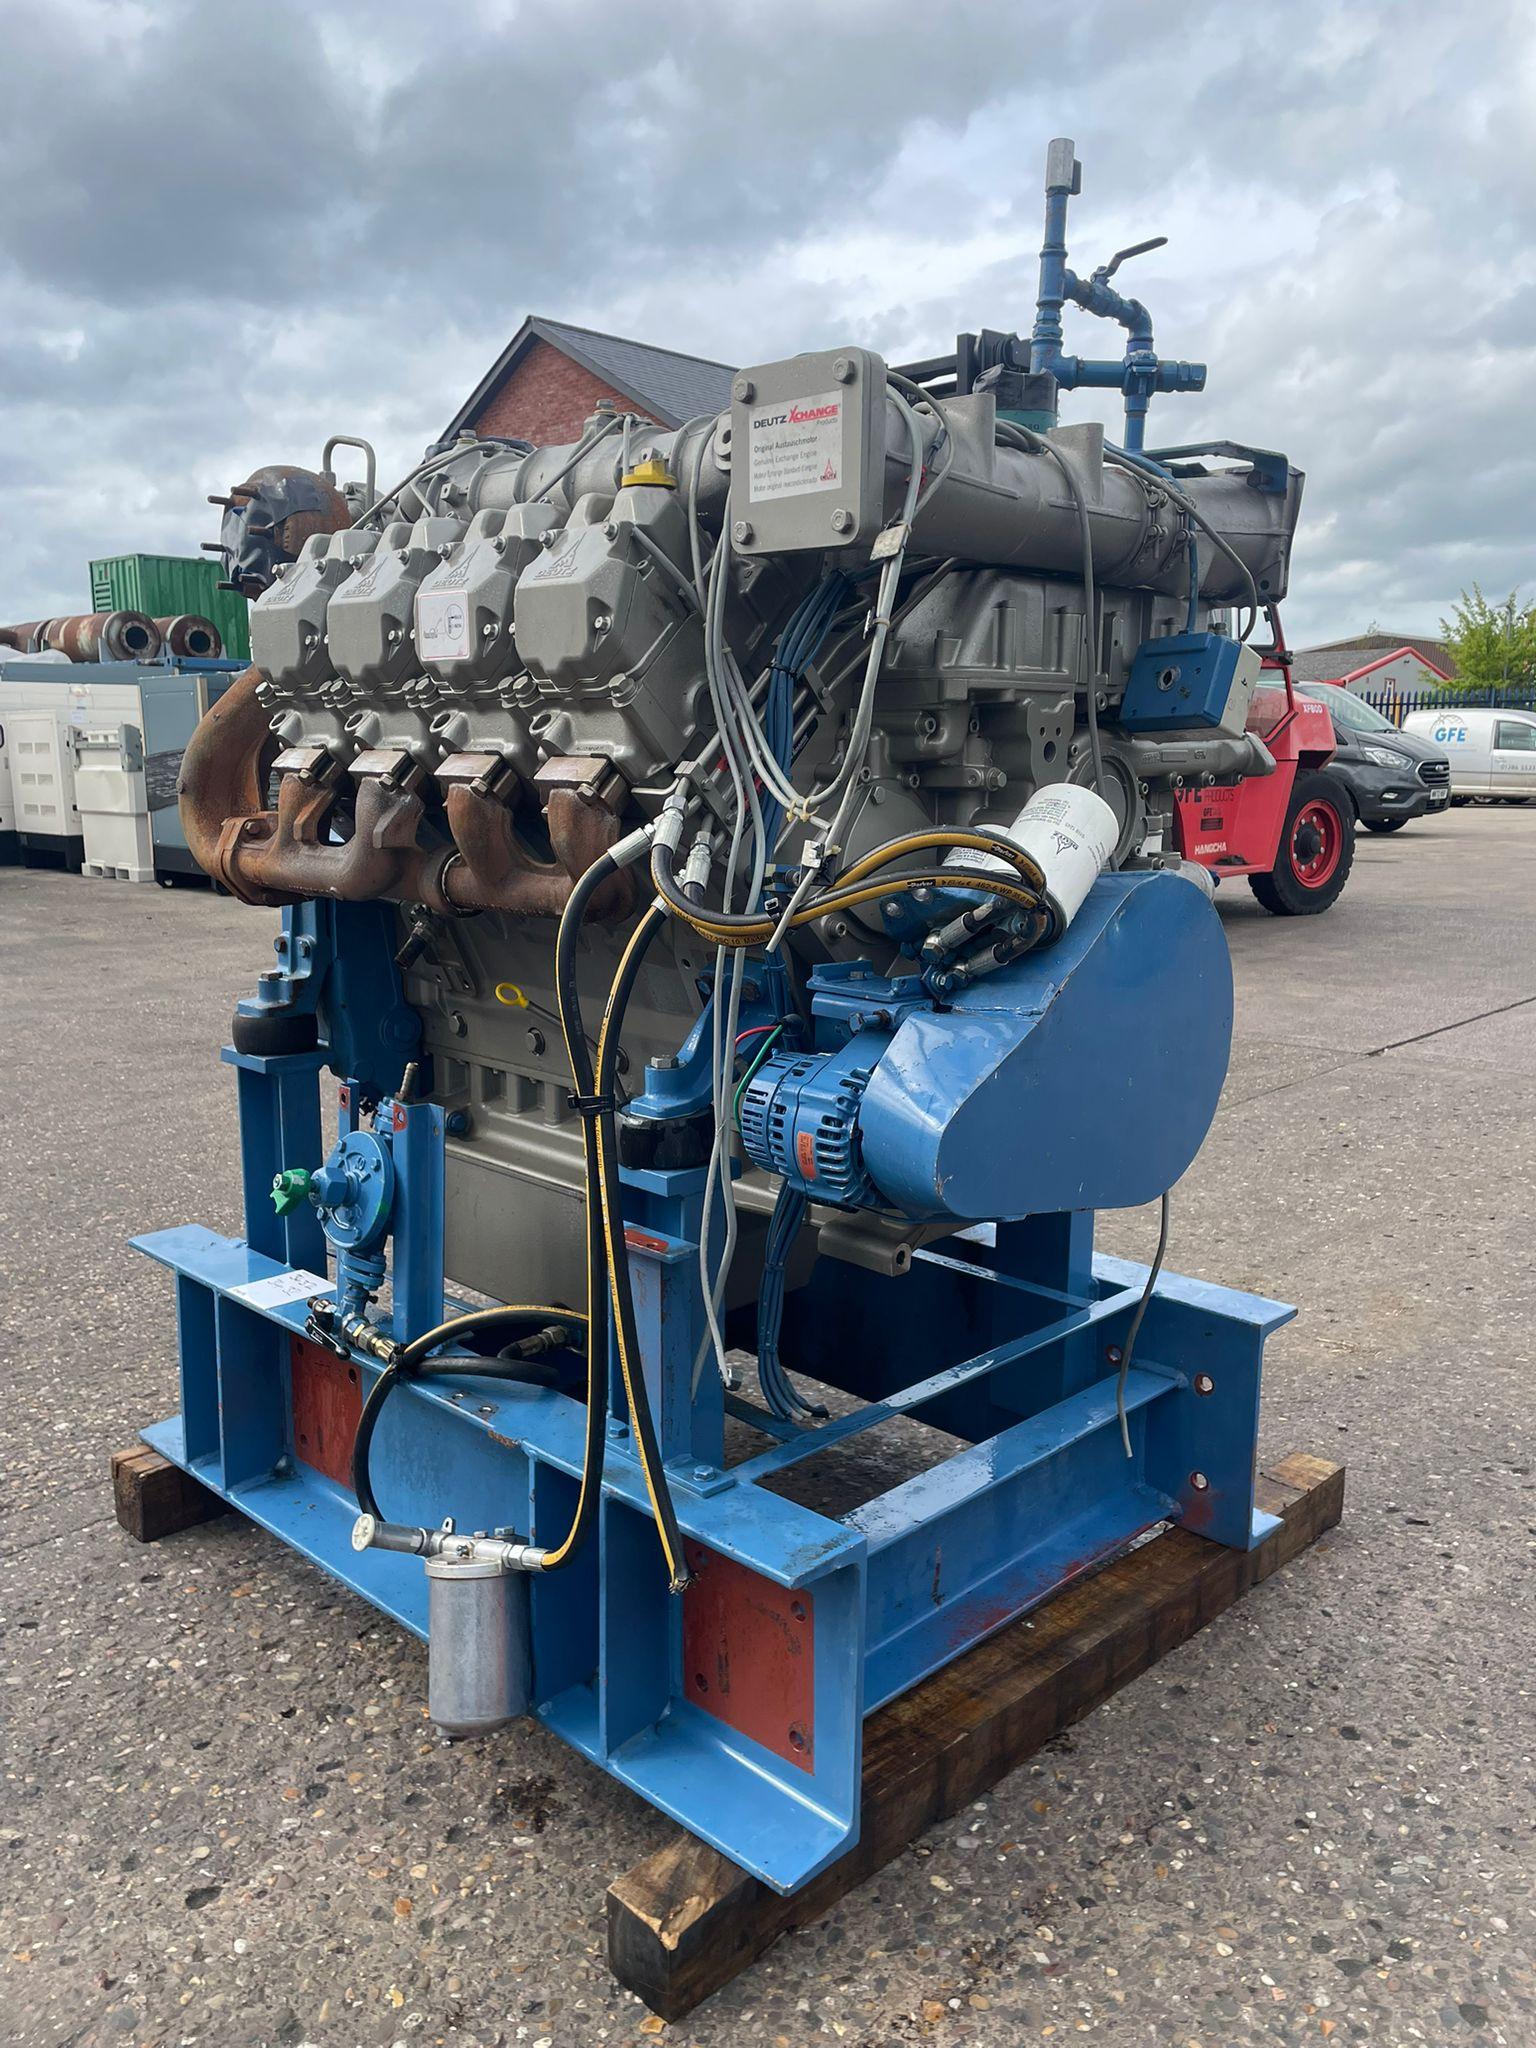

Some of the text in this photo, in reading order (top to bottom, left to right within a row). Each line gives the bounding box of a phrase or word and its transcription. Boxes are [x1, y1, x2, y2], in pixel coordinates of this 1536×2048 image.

[754, 405, 838, 429] DEUTZ XCHANGE
[754, 441, 774, 453] Original
[535, 567, 577, 578] DEUTZ
[433, 577, 470, 588] DEUTZ
[1435, 727, 1468, 742] GFE
[995, 846, 1015, 859] Parker
[1194, 842, 1227, 855] HANGCHA
[910, 880, 933, 888] Parker
